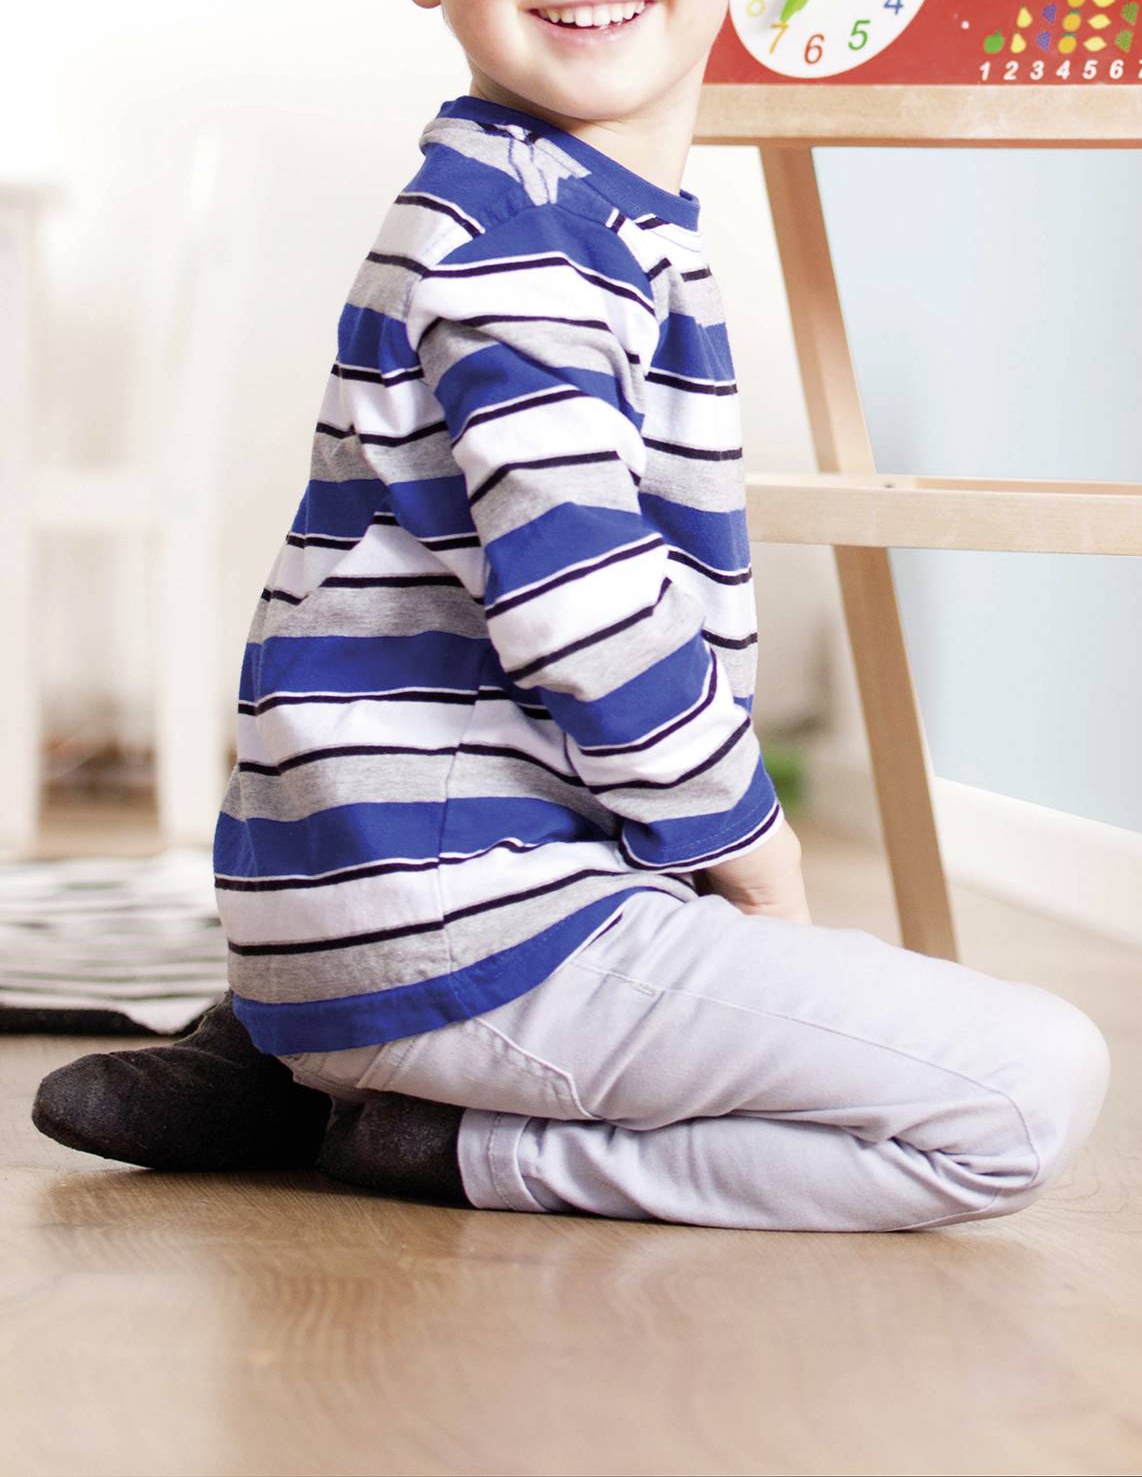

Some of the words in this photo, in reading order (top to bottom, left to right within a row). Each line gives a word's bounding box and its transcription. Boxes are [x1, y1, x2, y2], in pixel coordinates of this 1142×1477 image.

[769, 22, 789, 56] 7
[803, 32, 826, 65] 6
[848, 18, 871, 51] 5
[979, 62, 991, 81] 1
[1002, 60, 1019, 81] 2
[1029, 59, 1045, 81] 3
[1055, 59, 1071, 80] 4
[1082, 59, 1098, 80] 5
[1109, 59, 1125, 80] 6
